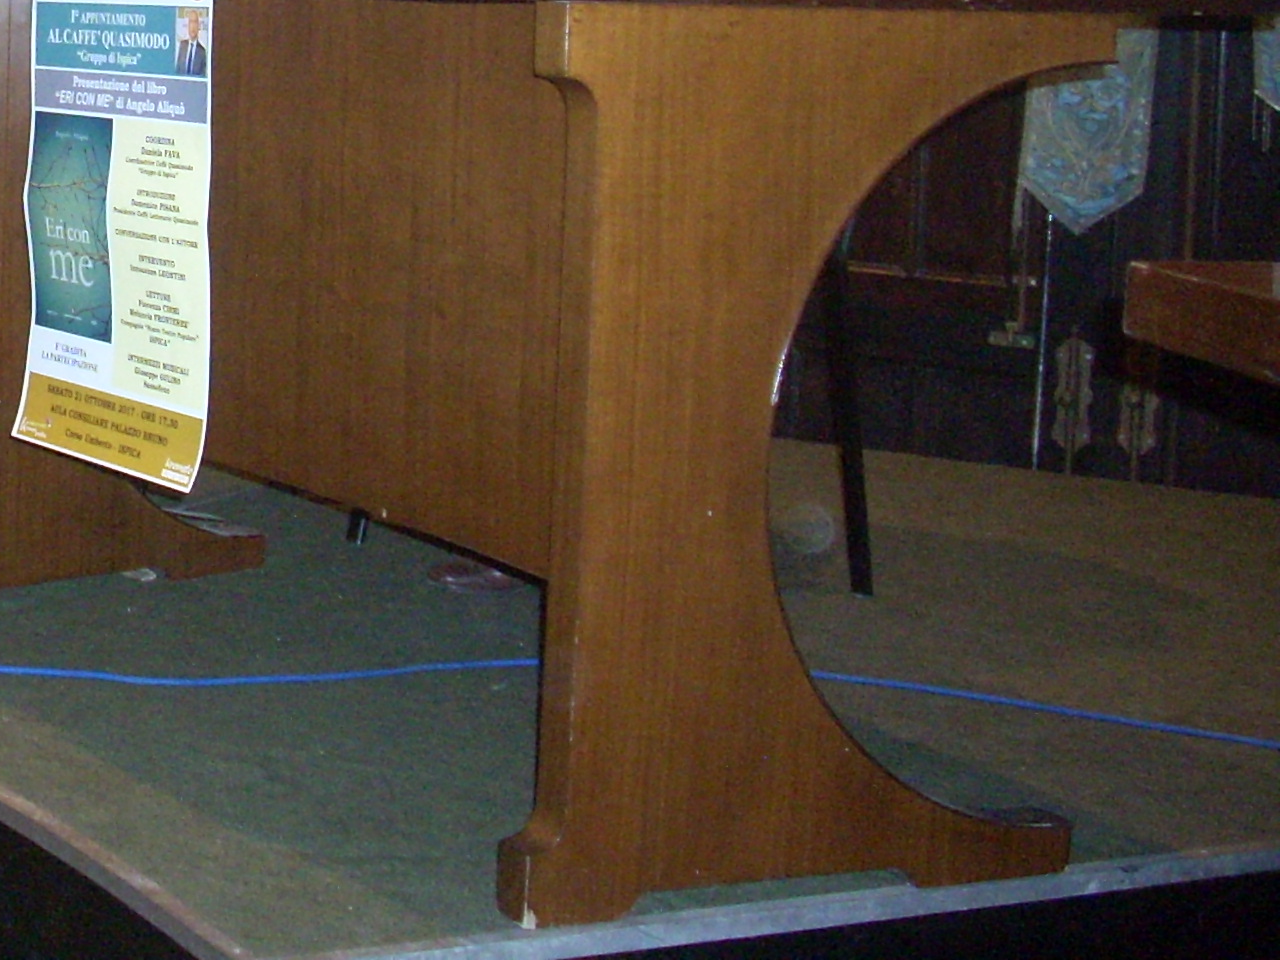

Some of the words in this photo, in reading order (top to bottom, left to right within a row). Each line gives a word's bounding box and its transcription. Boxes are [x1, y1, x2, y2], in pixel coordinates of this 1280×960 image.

[80, 12, 146, 27] APPUNTAMENTO
[47, 28, 62, 43] AL
[102, 31, 170, 50] QUASIMODO
[108, 52, 116, 63] di
[73, 75, 130, 92] Presentazione
[132, 80, 145, 93] del
[146, 81, 167, 95] libro
[76, 91, 96, 106] CON
[116, 96, 125, 109] di
[126, 97, 155, 115] Angelo
[45, 216, 64, 240] Eri
[67, 227, 91, 245] con
[49, 248, 95, 288] me
[84, 393, 116, 412] OTTOBRE
